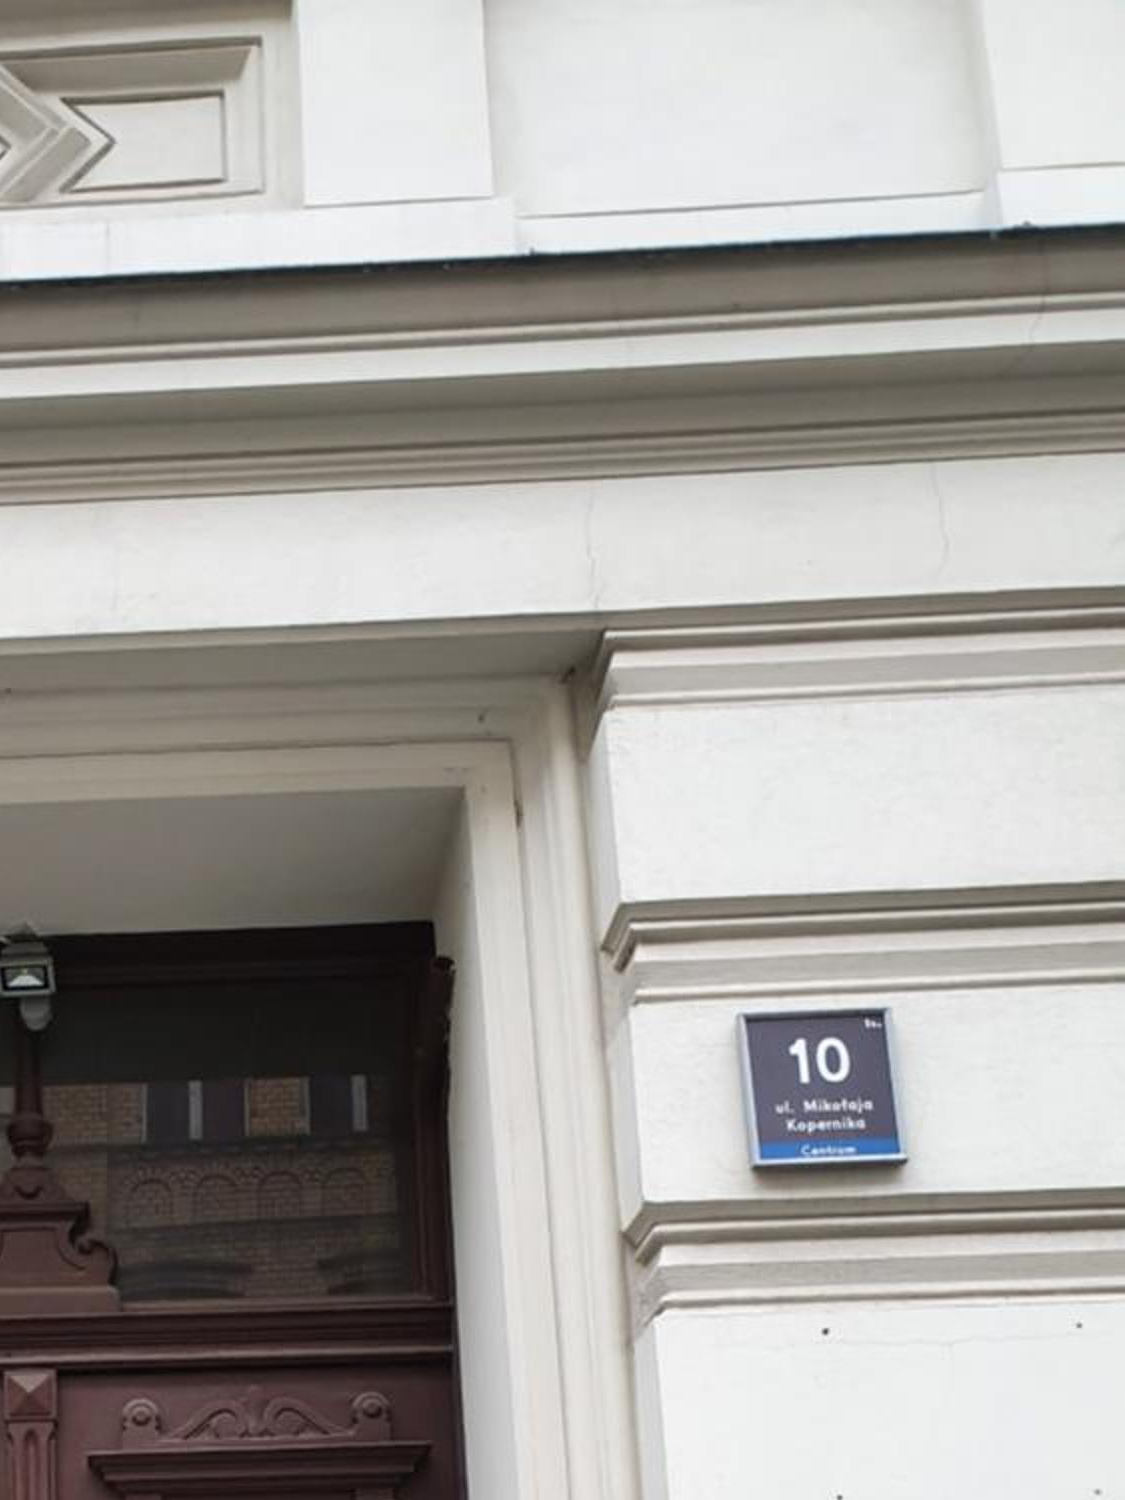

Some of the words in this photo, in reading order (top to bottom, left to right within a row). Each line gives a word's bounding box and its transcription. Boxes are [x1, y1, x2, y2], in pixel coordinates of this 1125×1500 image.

[788, 1037, 851, 1084] 10
[775, 1100, 795, 1114] ul.
[786, 1117, 867, 1133] Kopernika
